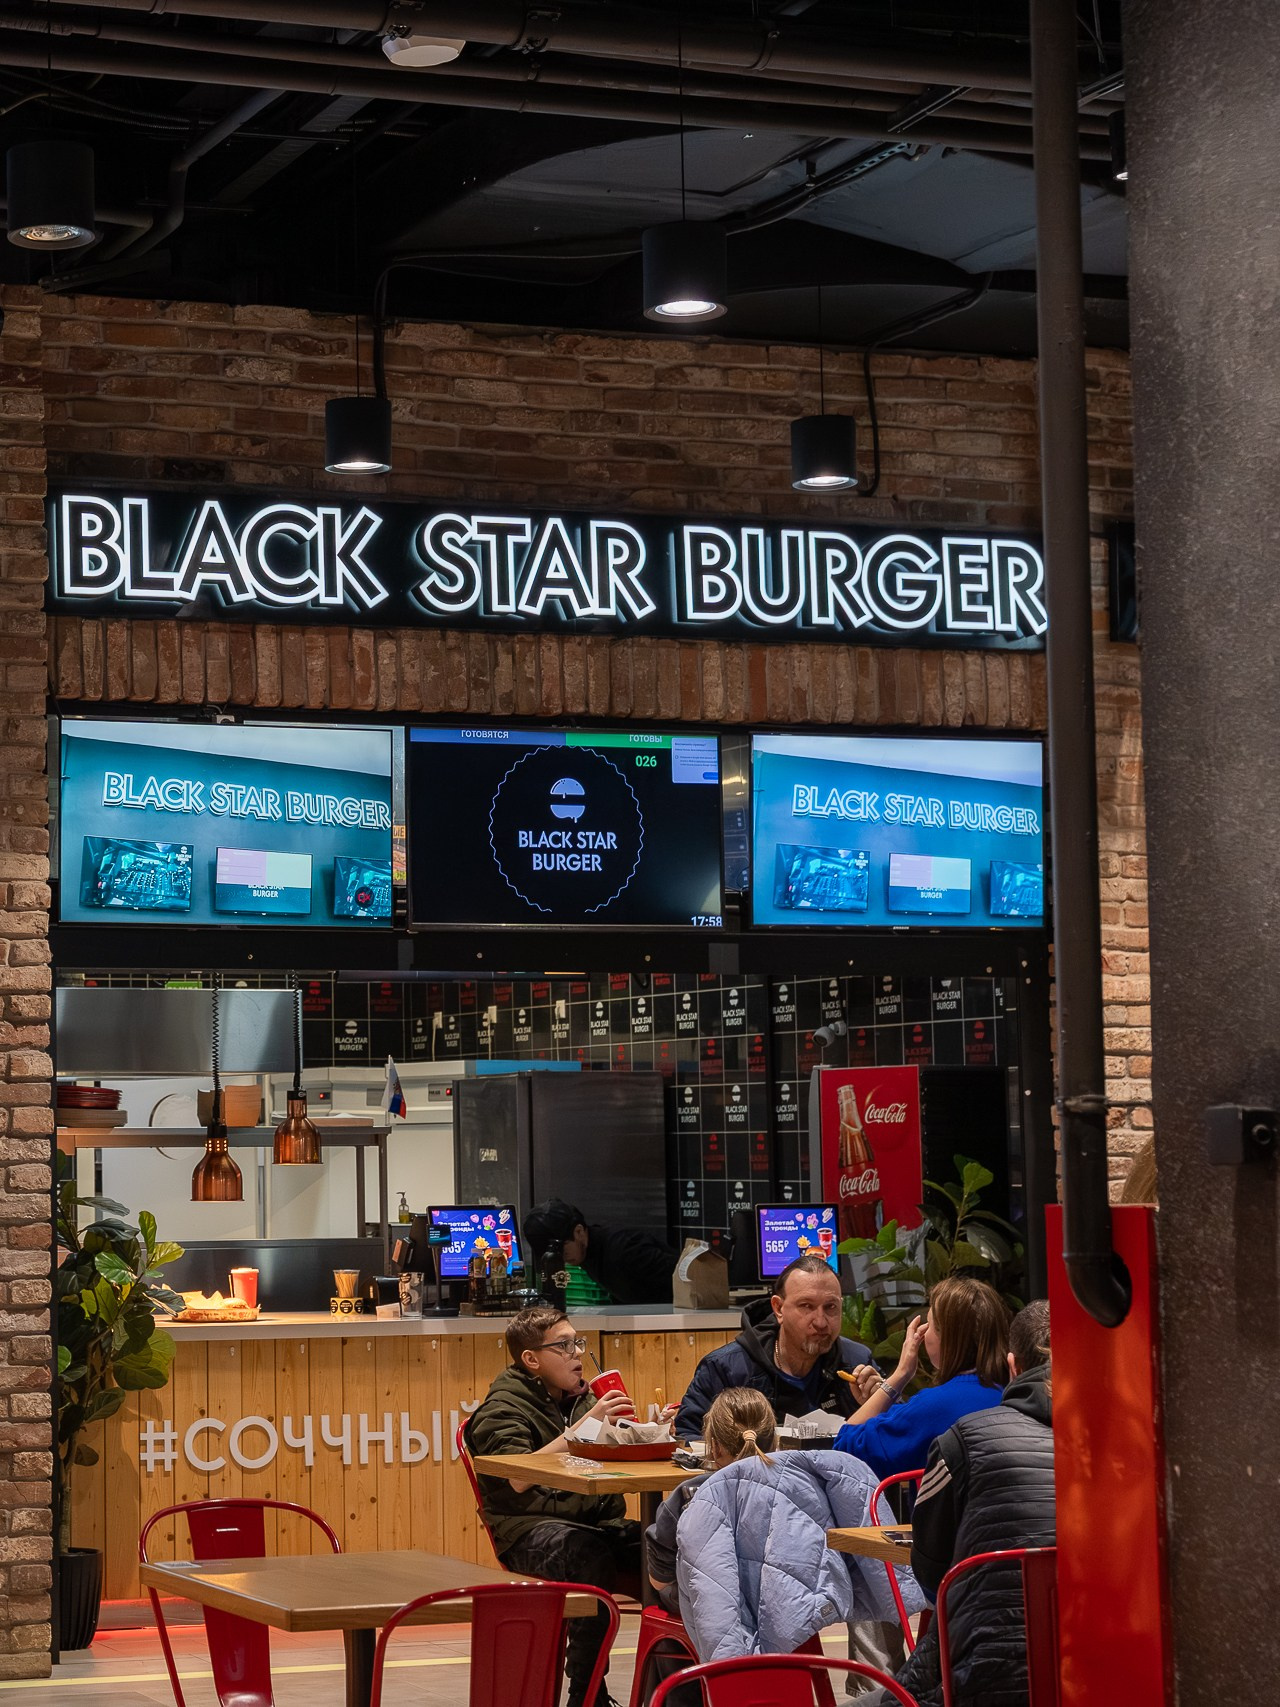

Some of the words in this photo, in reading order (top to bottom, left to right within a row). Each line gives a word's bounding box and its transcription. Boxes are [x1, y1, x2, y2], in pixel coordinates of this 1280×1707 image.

[62, 495, 390, 608] BLACK
[419, 513, 656, 620] STAR
[682, 525, 1047, 635] BURGER
[461, 730, 509, 739] ГОТОВЯТСЯ
[629, 734, 662, 743] ГОТОВЫ
[635, 756, 657, 768] 026
[103, 772, 205, 812] BLACK
[210, 782, 282, 820] STAR
[286, 791, 391, 830] BURGER
[792, 784, 880, 821] BLACK
[884, 793, 945, 826] STAR
[948, 800, 1040, 835] BURGER
[518, 830, 572, 848] BLACK
[576, 832, 618, 850] STAR
[532, 853, 602, 872] BURGER
[252, 890, 278, 898] BURGER
[691, 916, 722, 927] 17:58
[933, 992, 946, 1001] BLACK
[947, 990, 961, 1000] STAR
[936, 1001, 957, 1010] BURGER
[676, 1014, 688, 1022] BLACK
[726, 1018, 742, 1026] BURGER
[679, 1022, 695, 1030] BURGER
[865, 1103, 908, 1124] Coca-Cola
[840, 1168, 880, 1198] Coca-Cola
